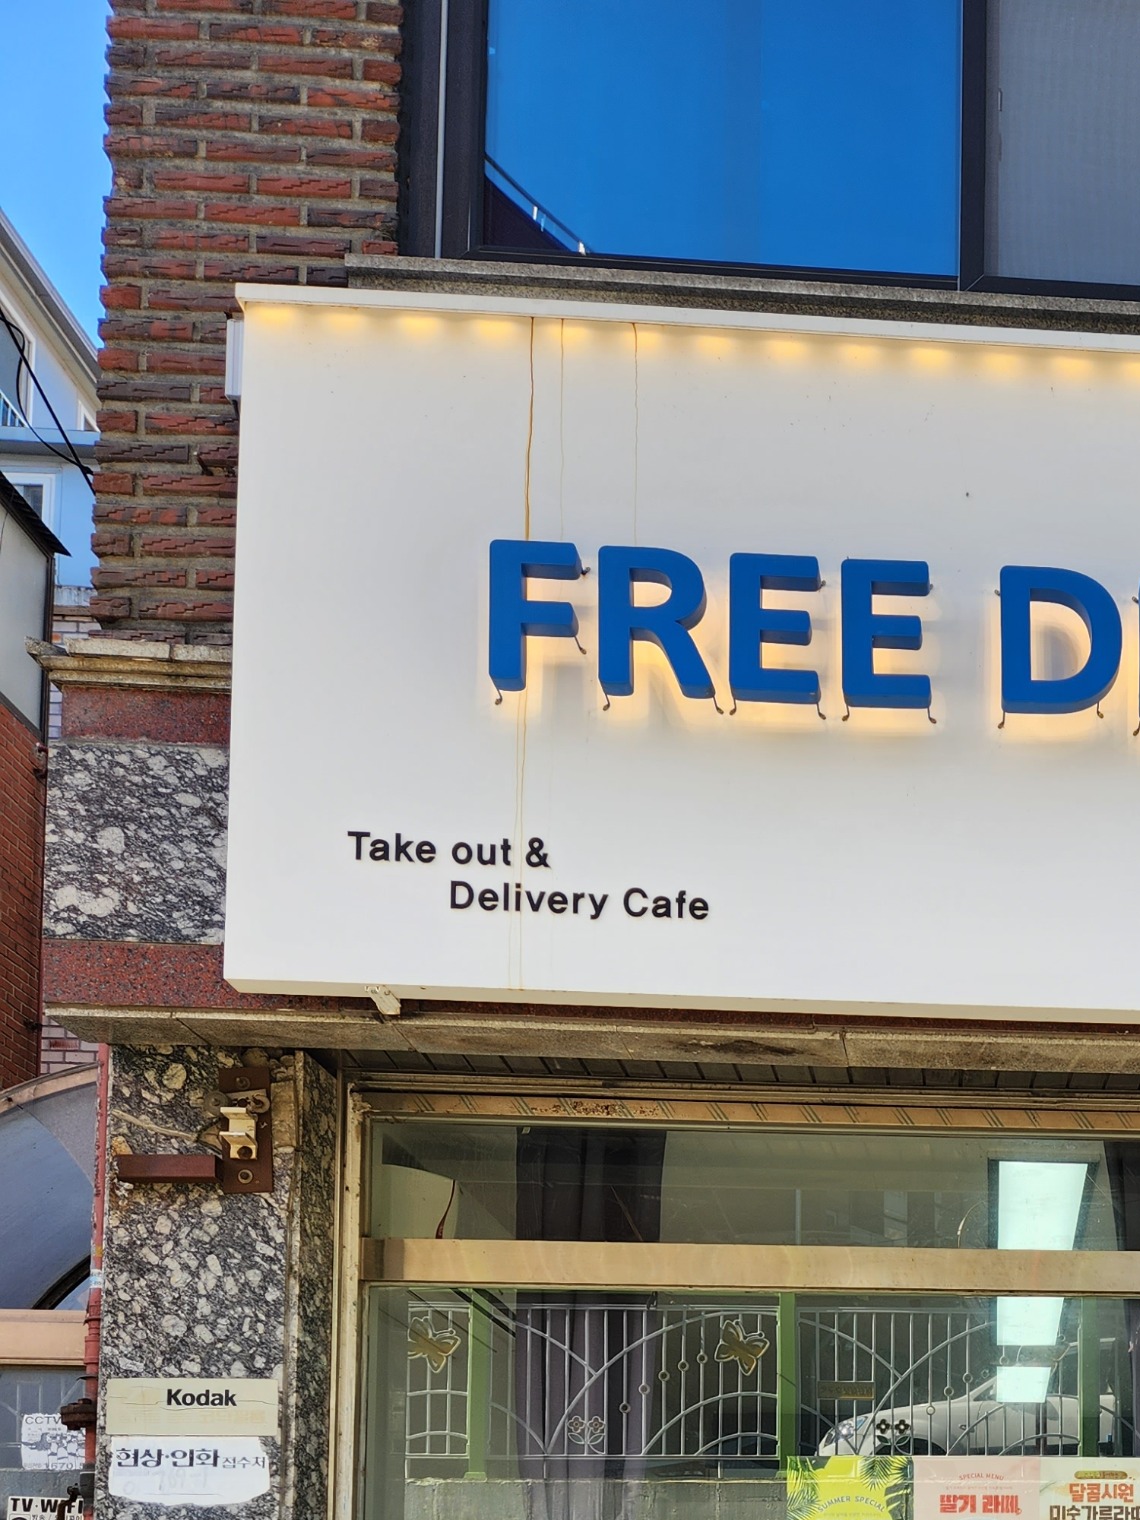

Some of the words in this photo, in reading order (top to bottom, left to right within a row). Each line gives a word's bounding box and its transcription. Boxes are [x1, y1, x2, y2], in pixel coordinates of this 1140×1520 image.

[490, 540, 931, 707] FREE
[347, 830, 437, 864] Take
[451, 838, 512, 866] out
[525, 837, 550, 868] &
[450, 880, 609, 920] Delivery
[623, 887, 709, 920] Cafe
[166, 1388, 237, 1407] Kodak
[25, 1416, 61, 1425] CCTV
[959, 1473, 985, 1481] SPECIAL
[1069, 1483, 1134, 1503] 달콤시원
[817, 1495, 851, 1513] SUMMER
[855, 1495, 885, 1513] SPECIAL
[940, 1495, 976, 1513] 딸기
